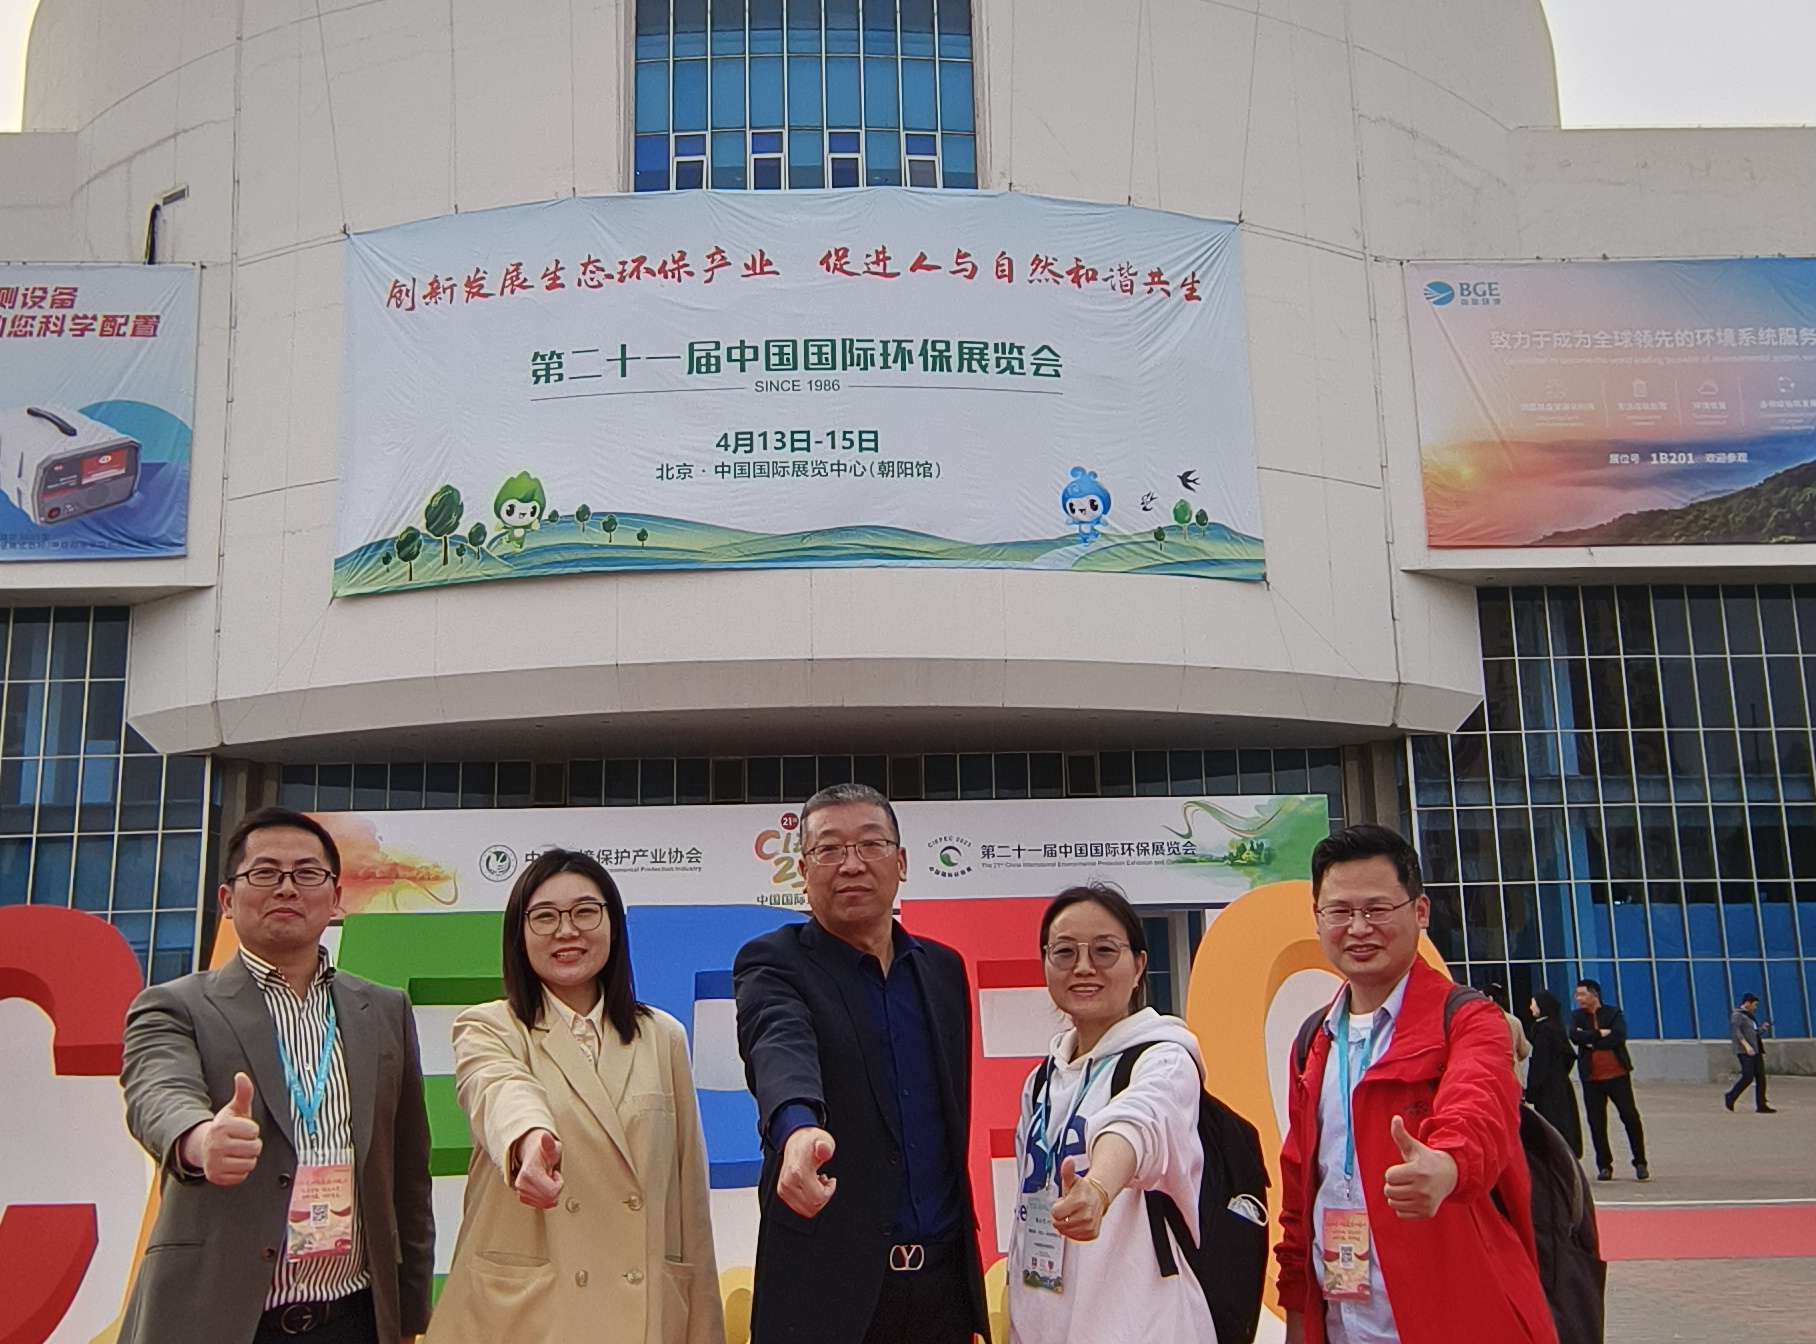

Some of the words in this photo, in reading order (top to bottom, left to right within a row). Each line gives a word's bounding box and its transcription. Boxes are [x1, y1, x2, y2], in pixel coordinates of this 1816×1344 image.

[386, 245, 781, 312] 创新发展生态环保产业
[819, 244, 1203, 302] 促进人与自然和谐共生
[1459, 282, 1500, 297] BGE
[0, 314, 161, 338] 您科学配置
[531, 338, 1062, 385] 第二十一届中国国际环保展览会
[754, 379, 801, 392] SINCE
[807, 378, 841, 392] 1986
[715, 430, 879, 454] 4月13日-15日
[1650, 452, 1695, 465] 1B201
[981, 840, 1197, 859] 第二十一届中国国际环保展览会
